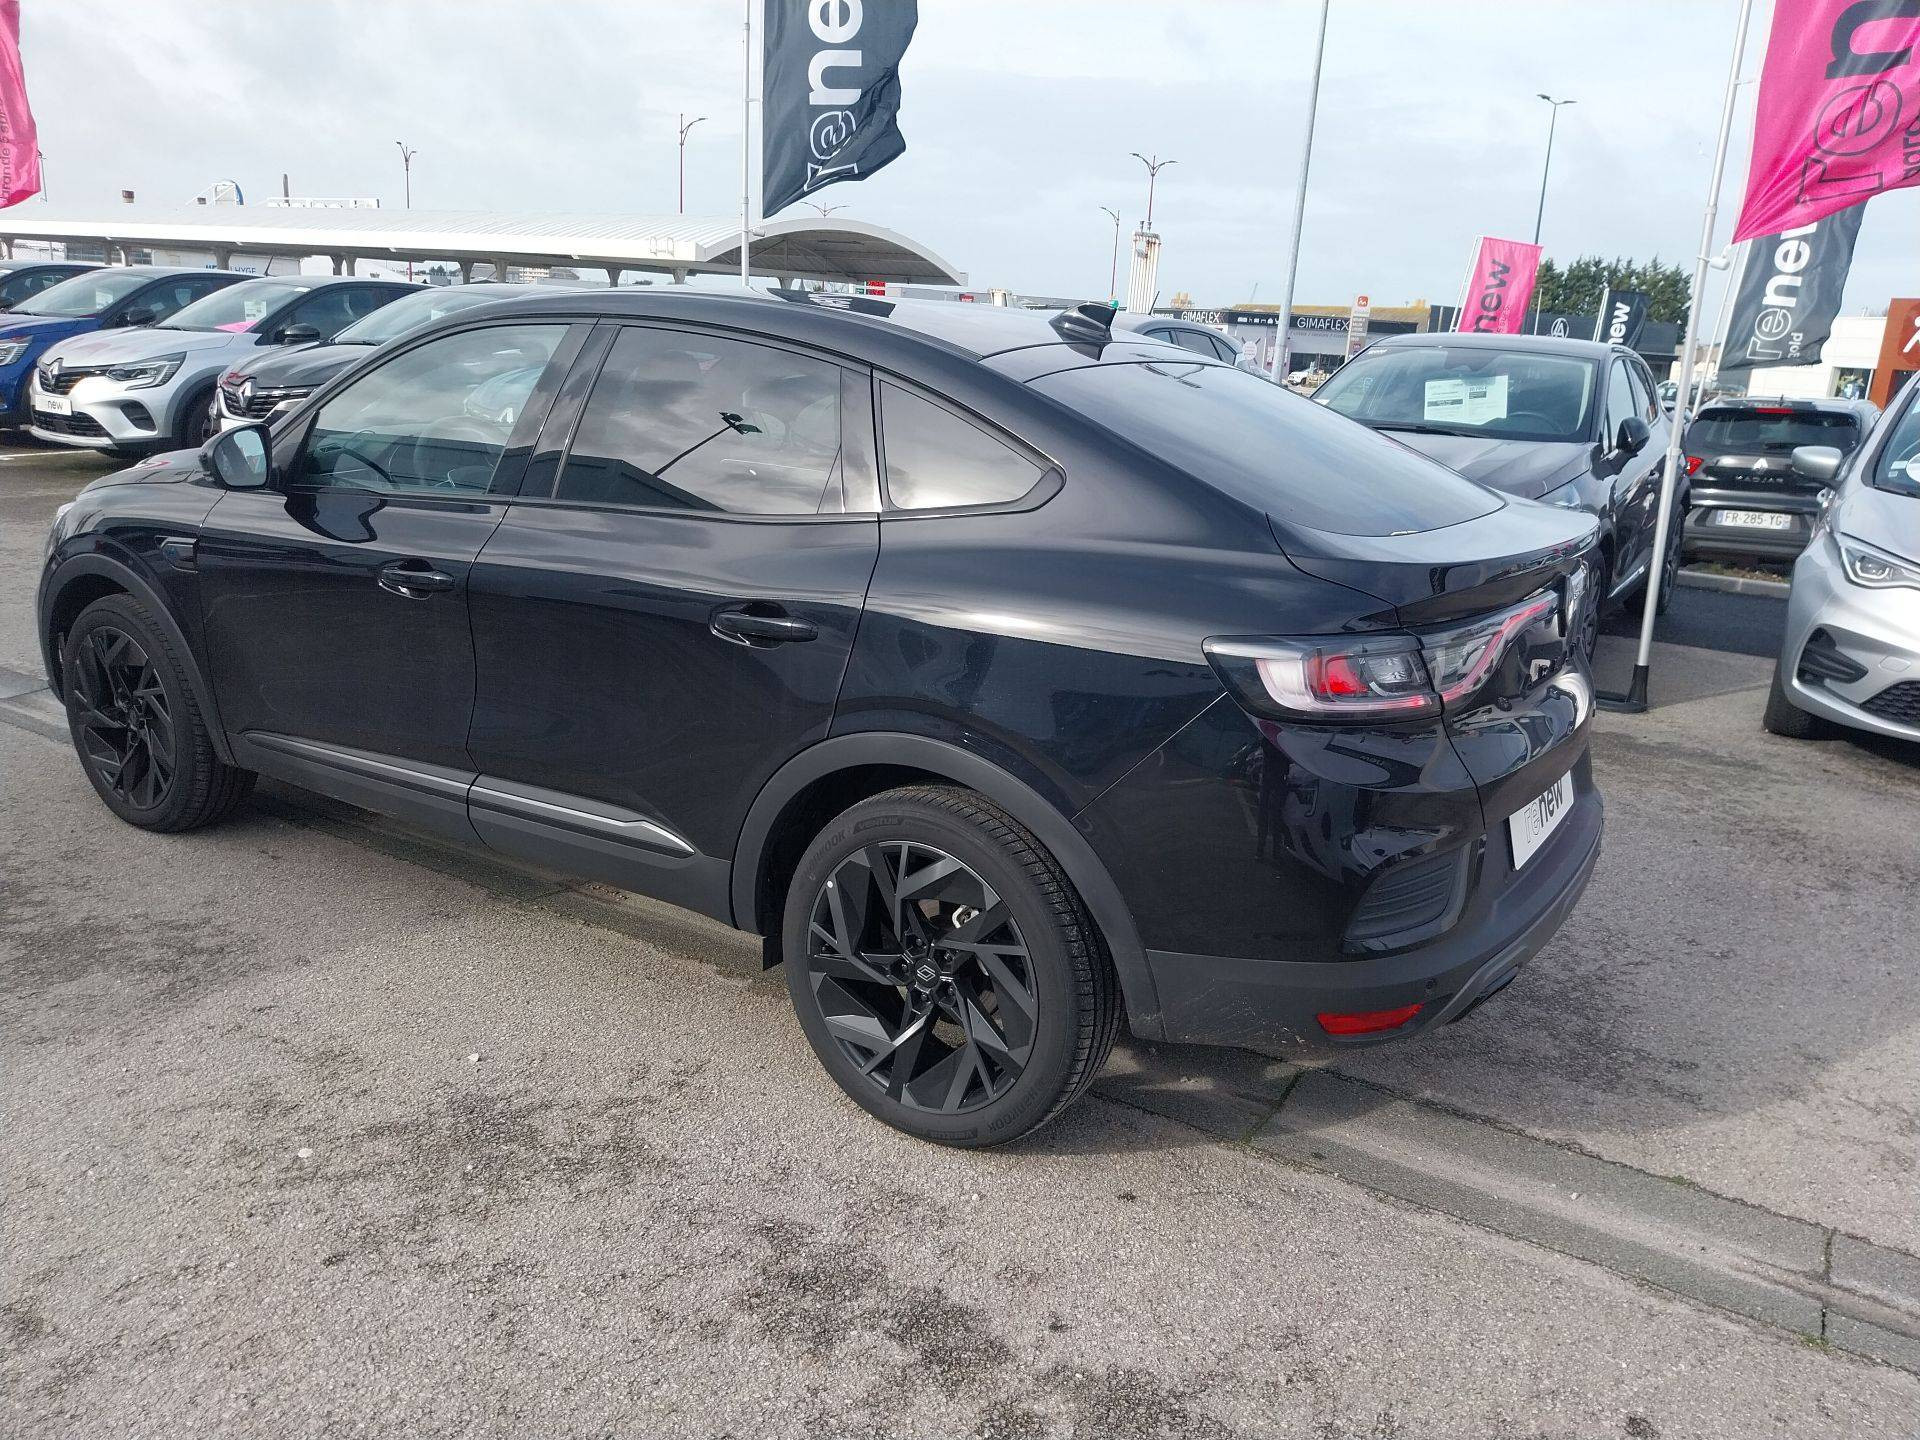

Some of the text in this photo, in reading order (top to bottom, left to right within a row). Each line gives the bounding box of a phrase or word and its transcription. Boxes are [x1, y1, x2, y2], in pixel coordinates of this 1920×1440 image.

[1181, 311, 1221, 324] GIMAFLEX
[1296, 316, 1351, 331] GIMAFLEX
[1724, 512, 1783, 527] FR-285-YG
[1523, 779, 1563, 844] renew
